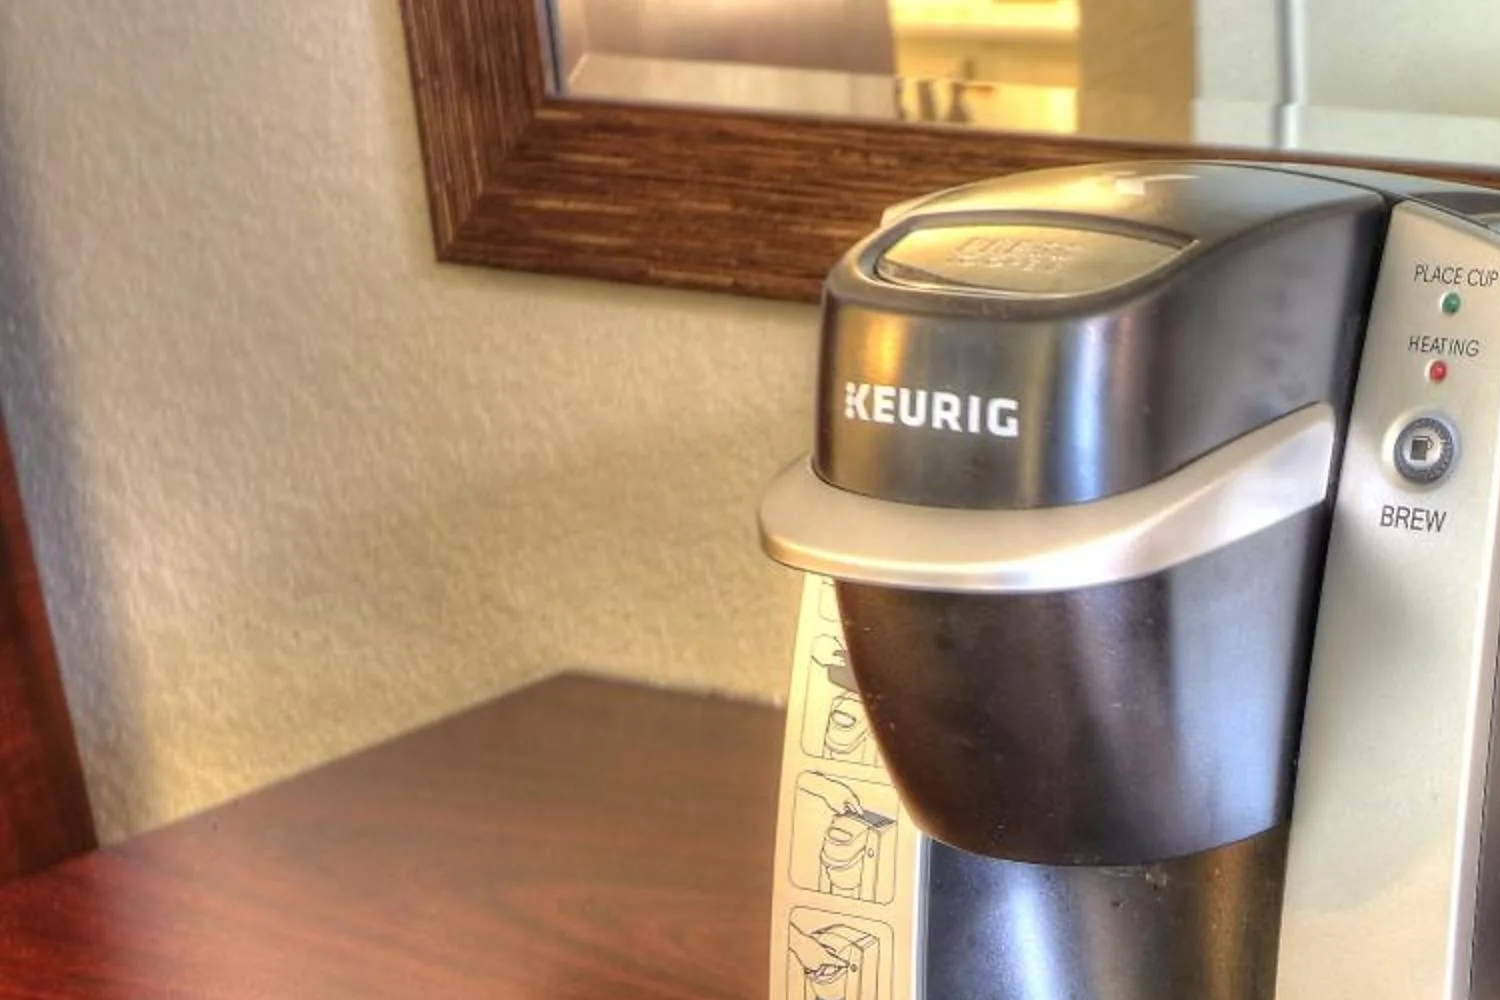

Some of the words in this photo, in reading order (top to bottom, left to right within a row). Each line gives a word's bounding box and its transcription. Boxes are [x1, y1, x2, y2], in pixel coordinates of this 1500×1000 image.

[1414, 263, 1464, 285] PLACE
[1467, 268, 1499, 287] CUP
[1408, 335, 1479, 357] HEATING
[845, 381, 1019, 437] KEURIG
[1380, 505, 1447, 532] BREW
